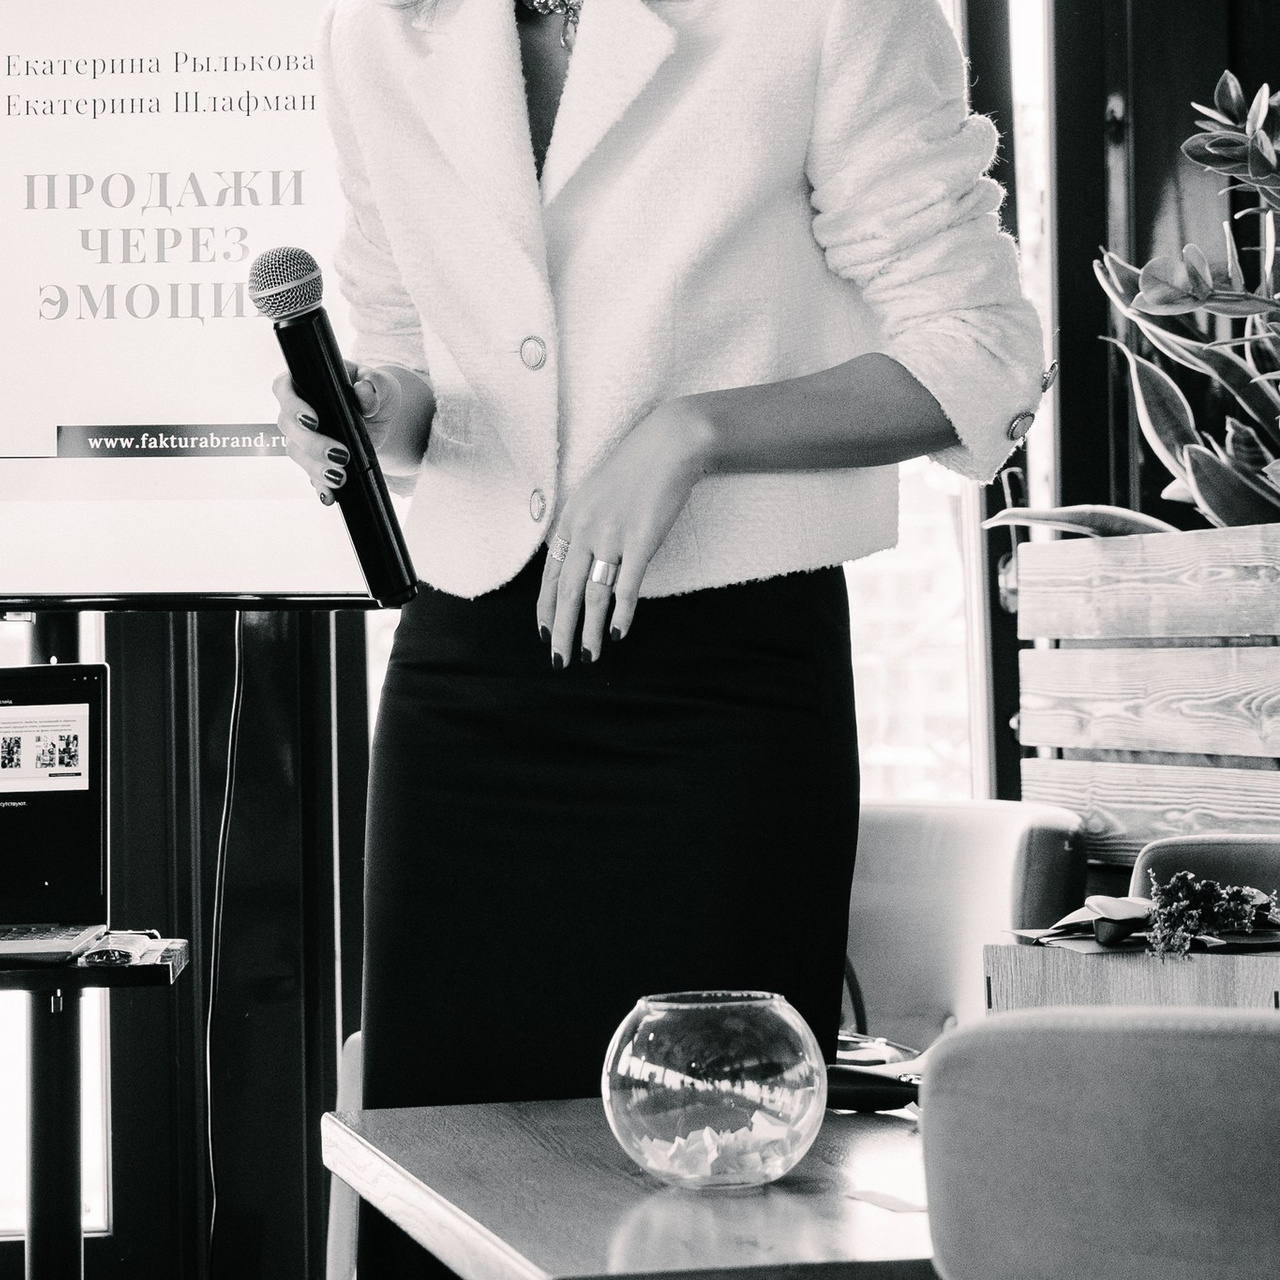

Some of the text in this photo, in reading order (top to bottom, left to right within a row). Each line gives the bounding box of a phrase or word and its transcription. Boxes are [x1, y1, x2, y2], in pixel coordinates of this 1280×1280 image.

[6, 51, 316, 80] Екатерина Рылькова
[6, 90, 318, 120] Екатерина Шлафман
[23, 170, 307, 217] ПРОДАЖИ
[78, 226, 250, 264] ЧЕРЕЗ
[39, 282, 268, 327] ЭМОЦИ
